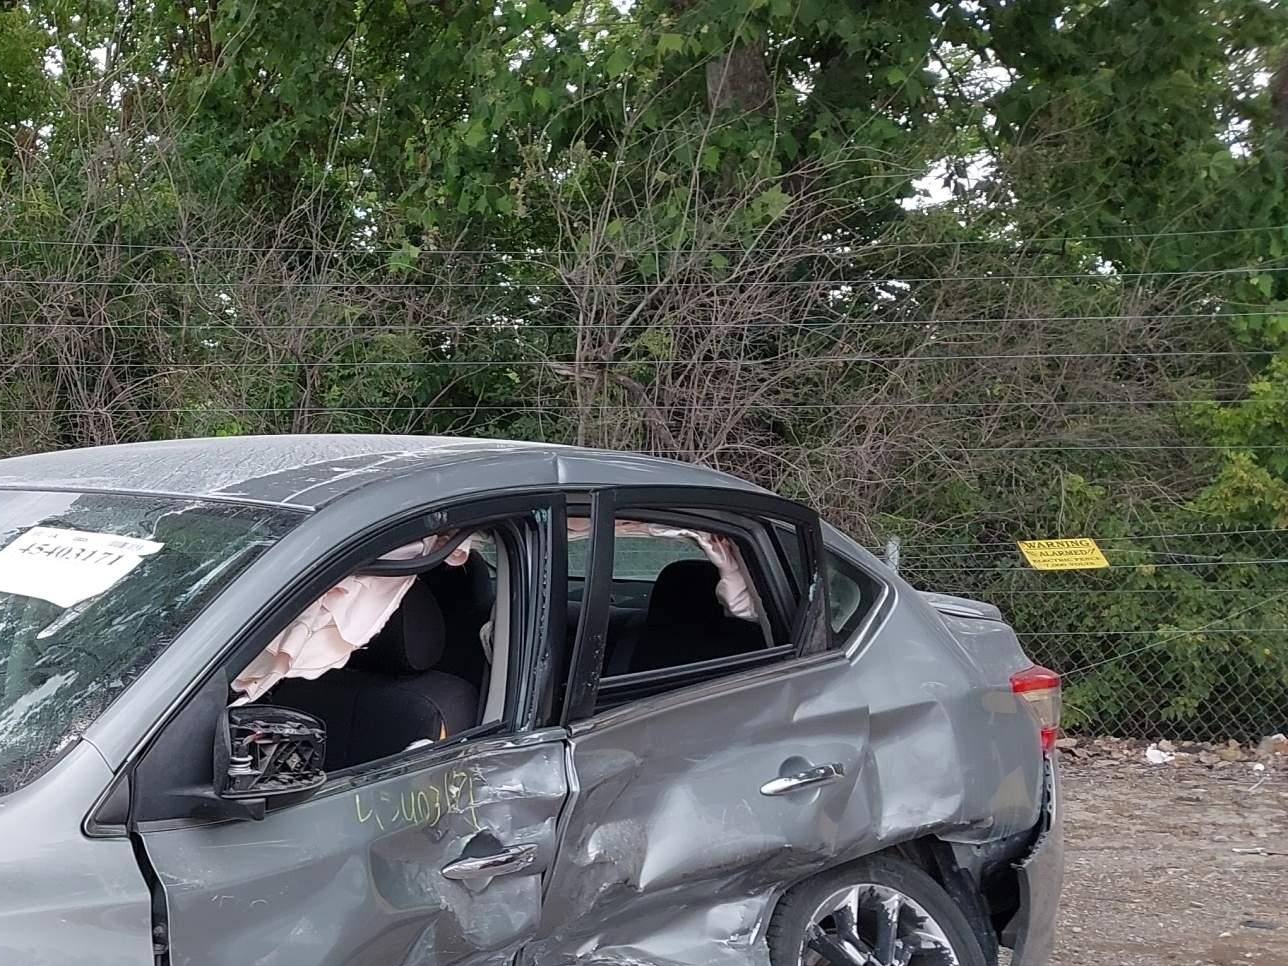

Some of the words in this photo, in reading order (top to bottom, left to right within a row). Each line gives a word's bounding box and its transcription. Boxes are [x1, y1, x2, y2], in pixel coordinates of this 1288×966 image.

[1023, 539, 1090, 549] WARNING
[18, 542, 125, 566] 45403171
[1039, 549, 1088, 557] ALARMED
